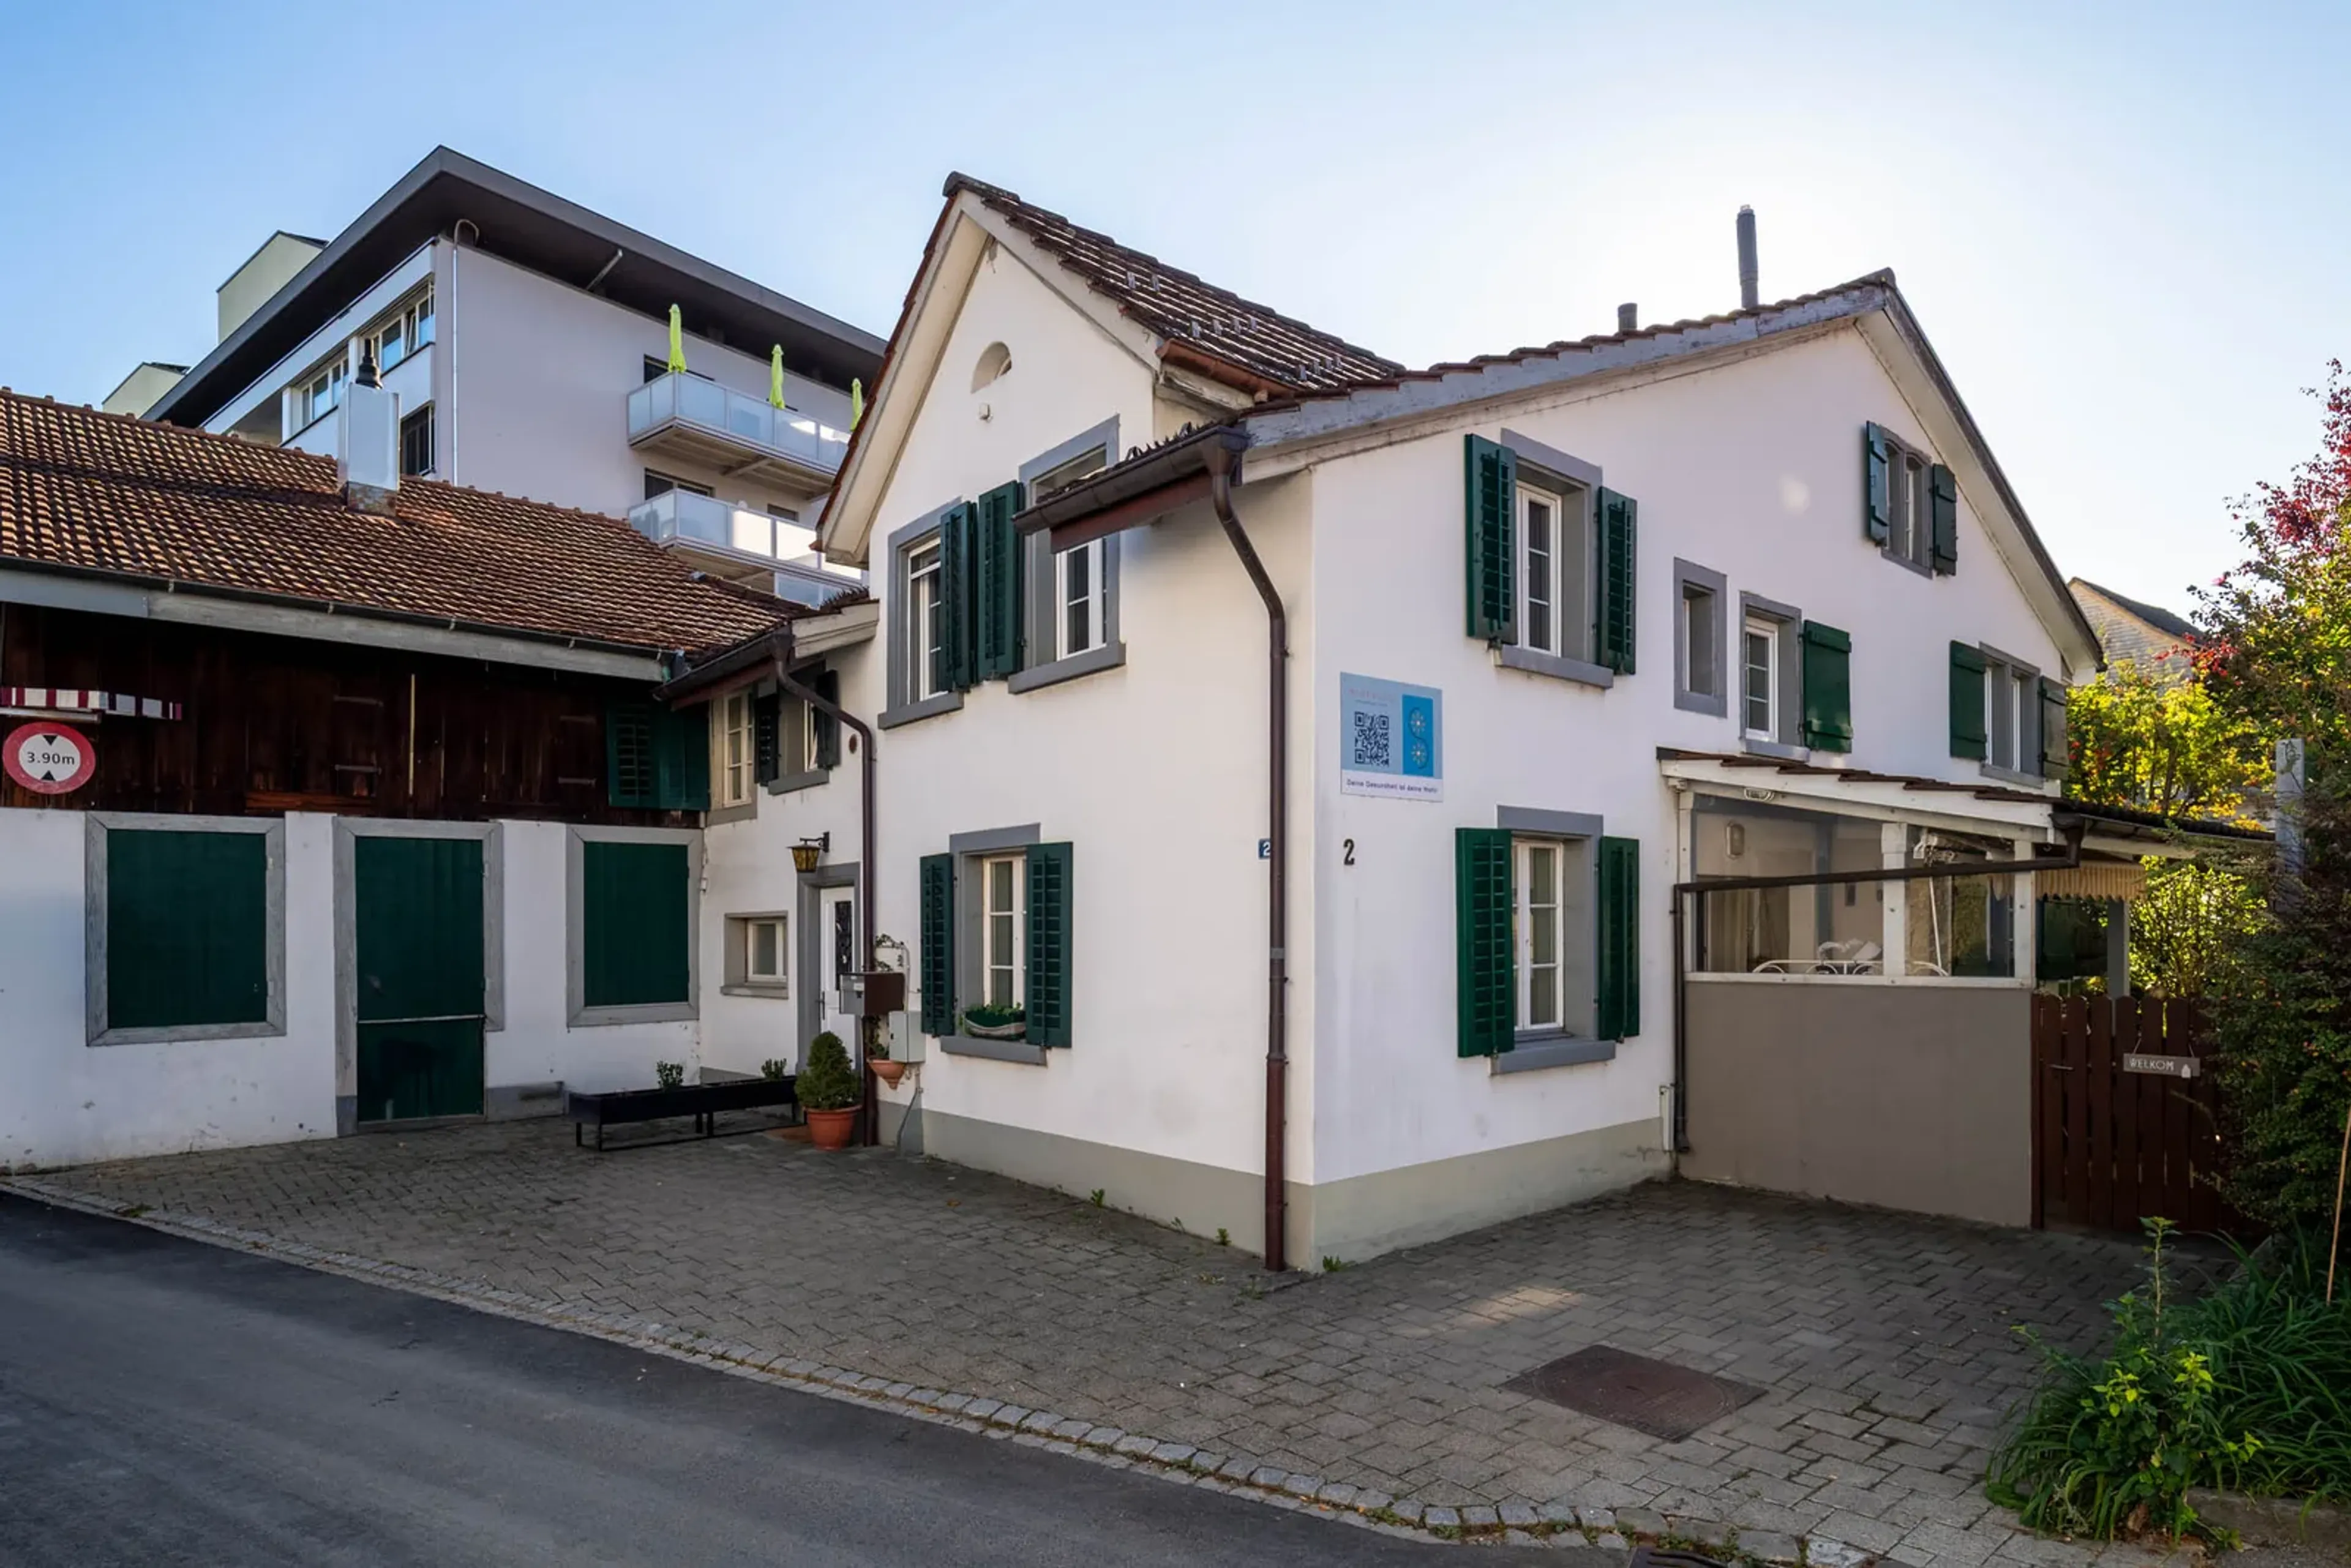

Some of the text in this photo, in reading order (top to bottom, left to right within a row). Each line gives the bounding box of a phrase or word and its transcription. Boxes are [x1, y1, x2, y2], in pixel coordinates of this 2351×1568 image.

[27, 752, 75, 765] 3.90m
[1263, 841, 1270, 857] 2
[1343, 839, 1355, 865] 2
[2129, 1058, 2174, 1070] WELKOM
